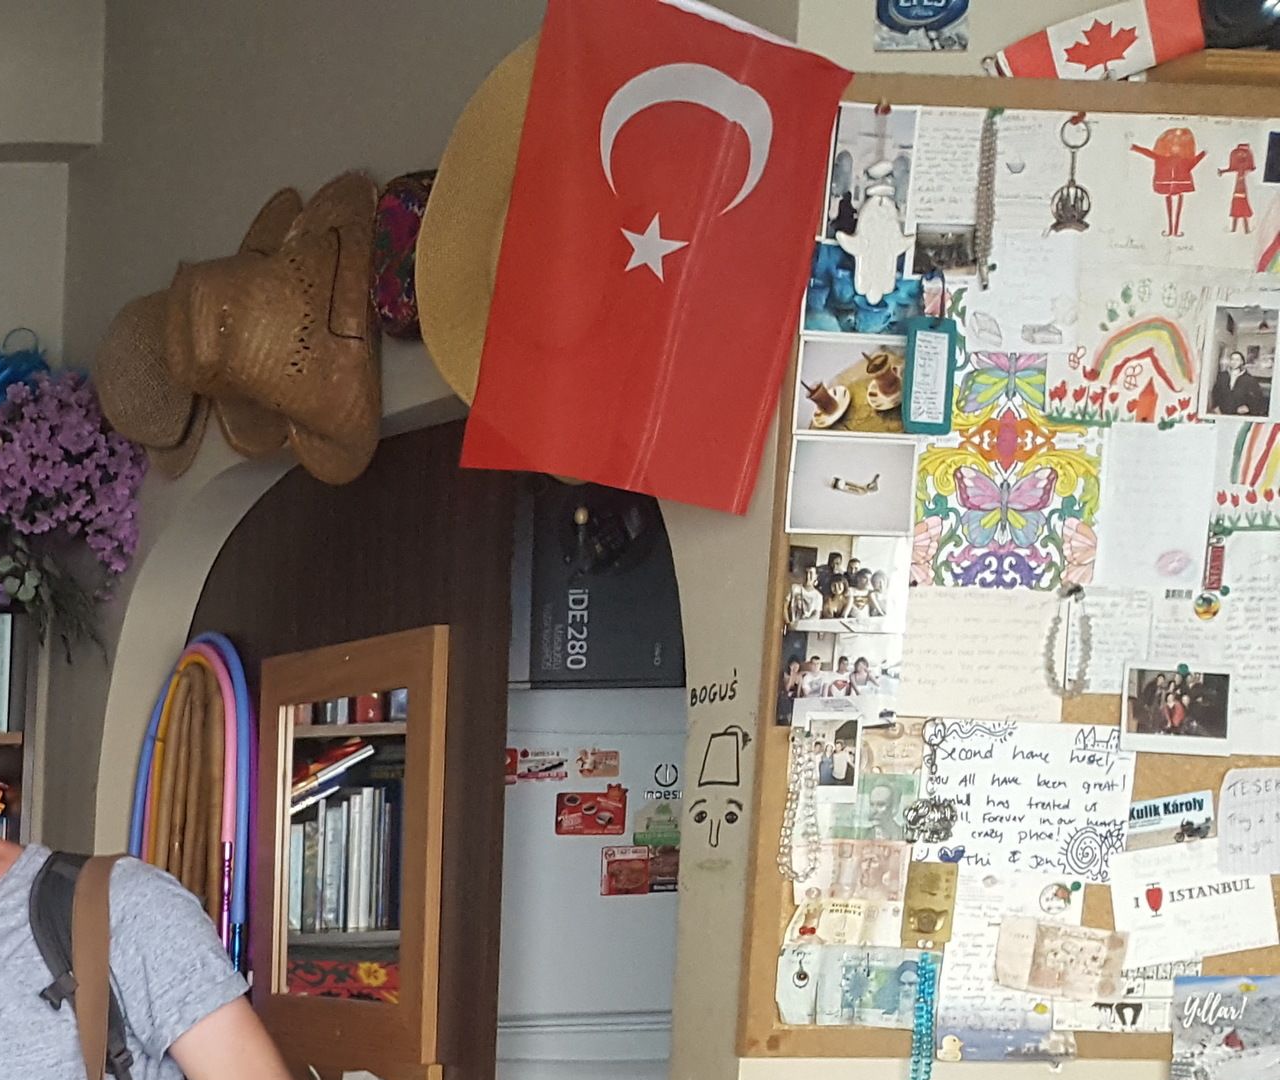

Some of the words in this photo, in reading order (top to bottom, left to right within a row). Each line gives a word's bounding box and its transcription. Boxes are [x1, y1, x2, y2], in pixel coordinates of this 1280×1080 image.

[566, 588, 589, 670] iDE280
[939, 743, 994, 762] Second
[1012, 744, 1050, 764] home
[1037, 773, 1067, 789] been
[1128, 801, 1161, 822] Kulik
[1162, 797, 1205, 818] Károly
[1133, 896, 1141, 909] I
[1168, 877, 1255, 904] ISTANBUL
